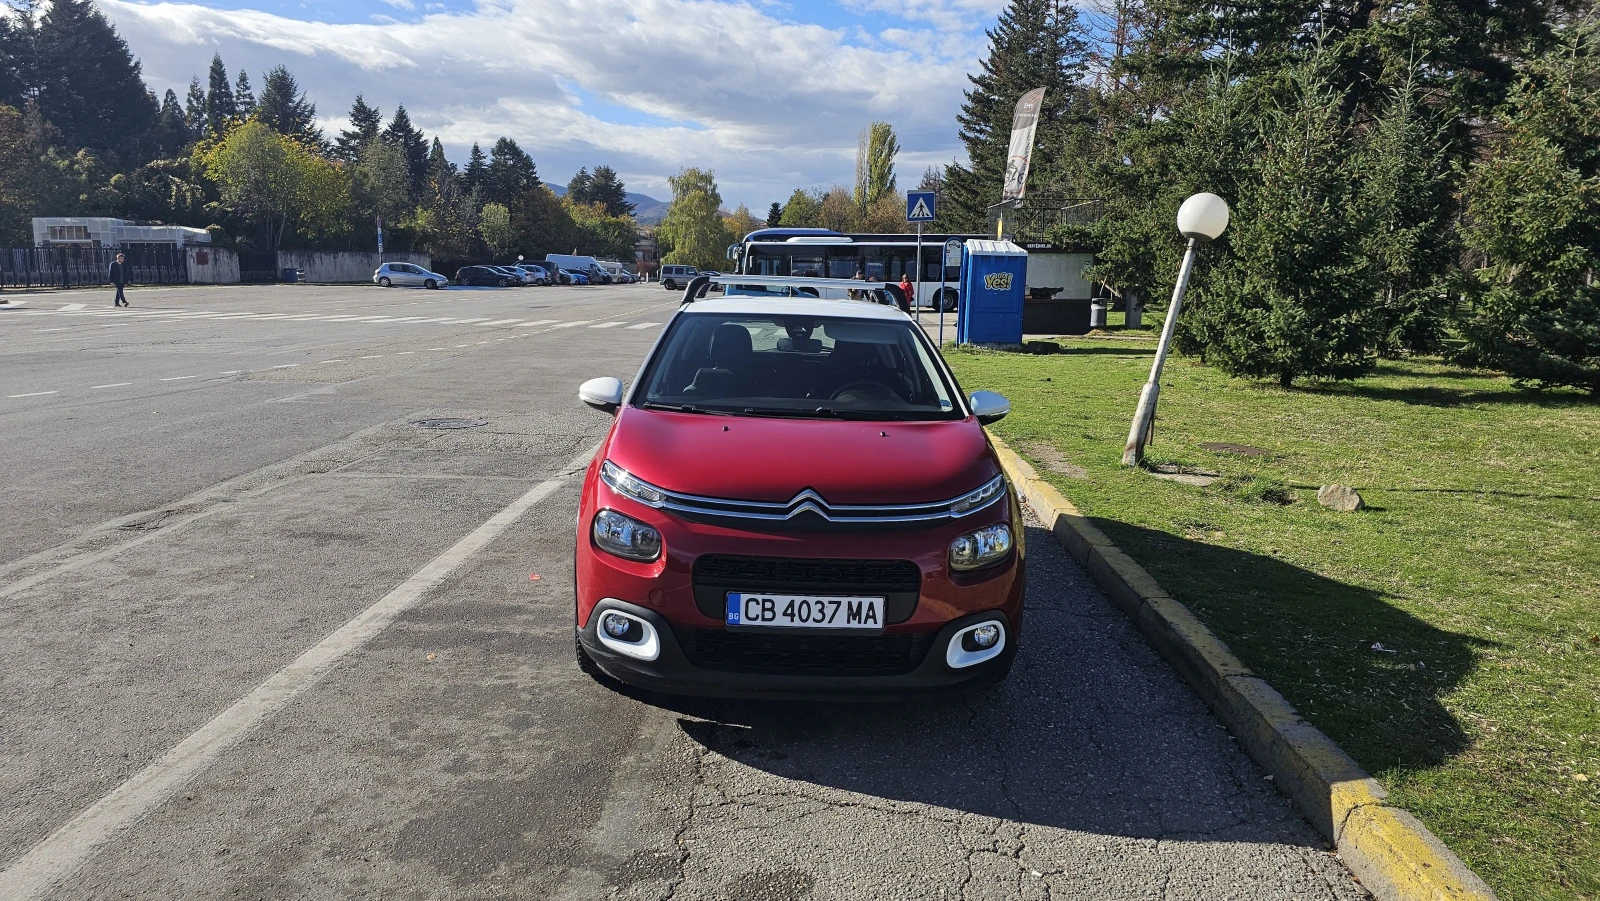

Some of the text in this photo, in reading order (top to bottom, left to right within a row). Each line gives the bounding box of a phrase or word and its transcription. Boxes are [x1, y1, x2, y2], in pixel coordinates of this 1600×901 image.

[728, 612, 739, 620] BG
[744, 598, 878, 625] CB 4037 MA
